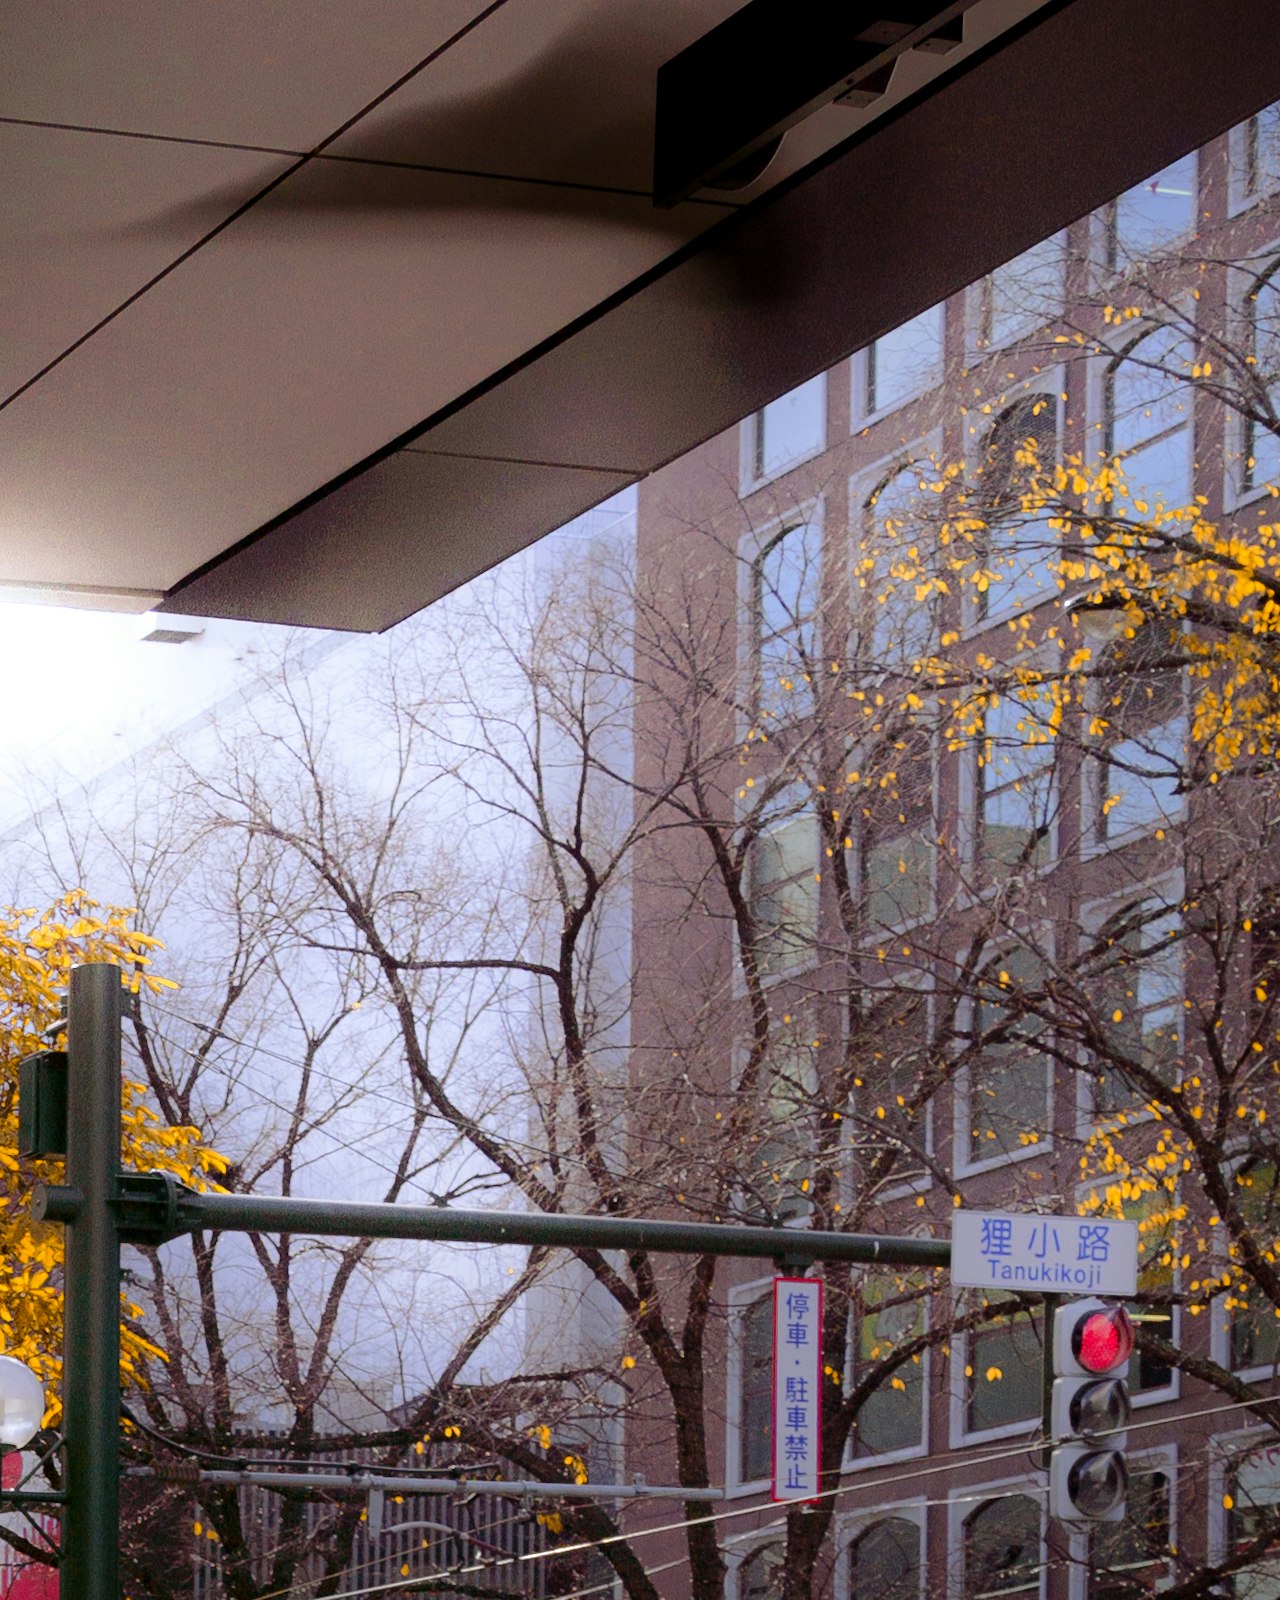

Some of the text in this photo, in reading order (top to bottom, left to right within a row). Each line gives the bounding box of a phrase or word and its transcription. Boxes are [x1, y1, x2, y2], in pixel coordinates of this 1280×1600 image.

[981, 1218, 1110, 1261] 狸小路
[988, 1259, 1101, 1288] Tanukikoji
[785, 1292, 809, 1490] 停車・駐車禁止
